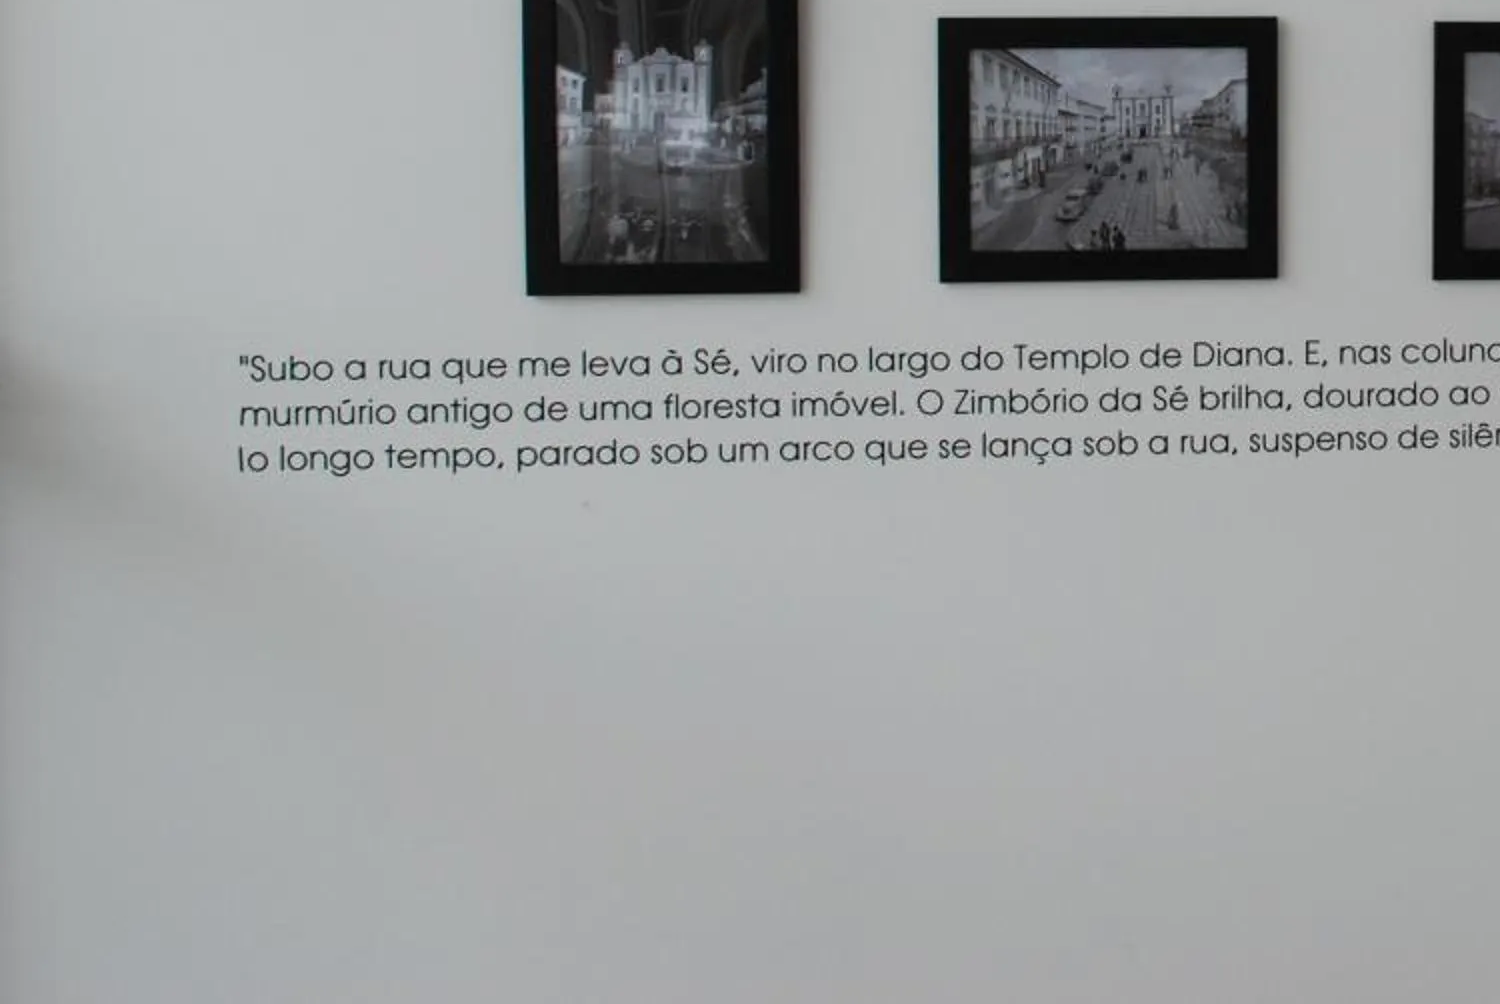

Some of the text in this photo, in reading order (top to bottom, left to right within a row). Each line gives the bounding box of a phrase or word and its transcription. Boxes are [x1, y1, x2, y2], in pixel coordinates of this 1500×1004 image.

[238, 354, 335, 383] "Subo
[343, 358, 367, 381] a
[377, 358, 432, 381] rua
[441, 357, 508, 386] que
[518, 355, 572, 379] me
[581, 349, 651, 378] leva
[660, 348, 684, 376] à
[693, 347, 740, 378] Sé,
[750, 347, 808, 375] viro
[817, 352, 859, 374] no
[868, 345, 952, 380] largo
[959, 344, 1005, 372] do
[1012, 342, 1130, 376] Templo
[1139, 342, 1183, 369] de
[1192, 340, 1294, 368] Diana.
[1304, 339, 1329, 369] E,
[1338, 343, 1392, 366] nas
[239, 397, 397, 428] murmúrio
[406, 396, 514, 431] antigo
[523, 395, 569, 424] de
[578, 399, 653, 422] uma
[663, 392, 782, 421] floresta
[791, 389, 906, 418] imóvel.
[916, 388, 945, 417] O
[953, 387, 1090, 416] Zimbório
[1098, 386, 1143, 414] da
[1152, 384, 1189, 413] Sé
[1199, 383, 1293, 413] brilha,
[1302, 380, 1440, 410] dourado
[1448, 384, 1491, 407] ao
[237, 445, 270, 474] lo
[279, 443, 375, 478] longo
[383, 443, 505, 476] tempo,
[516, 437, 641, 474] parado
[650, 436, 709, 466] sob
[717, 440, 770, 464] um
[778, 439, 856, 463] arco
[863, 438, 929, 467] que
[938, 438, 973, 460] se
[981, 431, 1073, 466] lança
[1082, 429, 1140, 458] sob
[1147, 434, 1169, 456] a
[1179, 432, 1238, 456] rua,
[1248, 429, 1389, 459] suspenso
[1396, 423, 1440, 451] de
